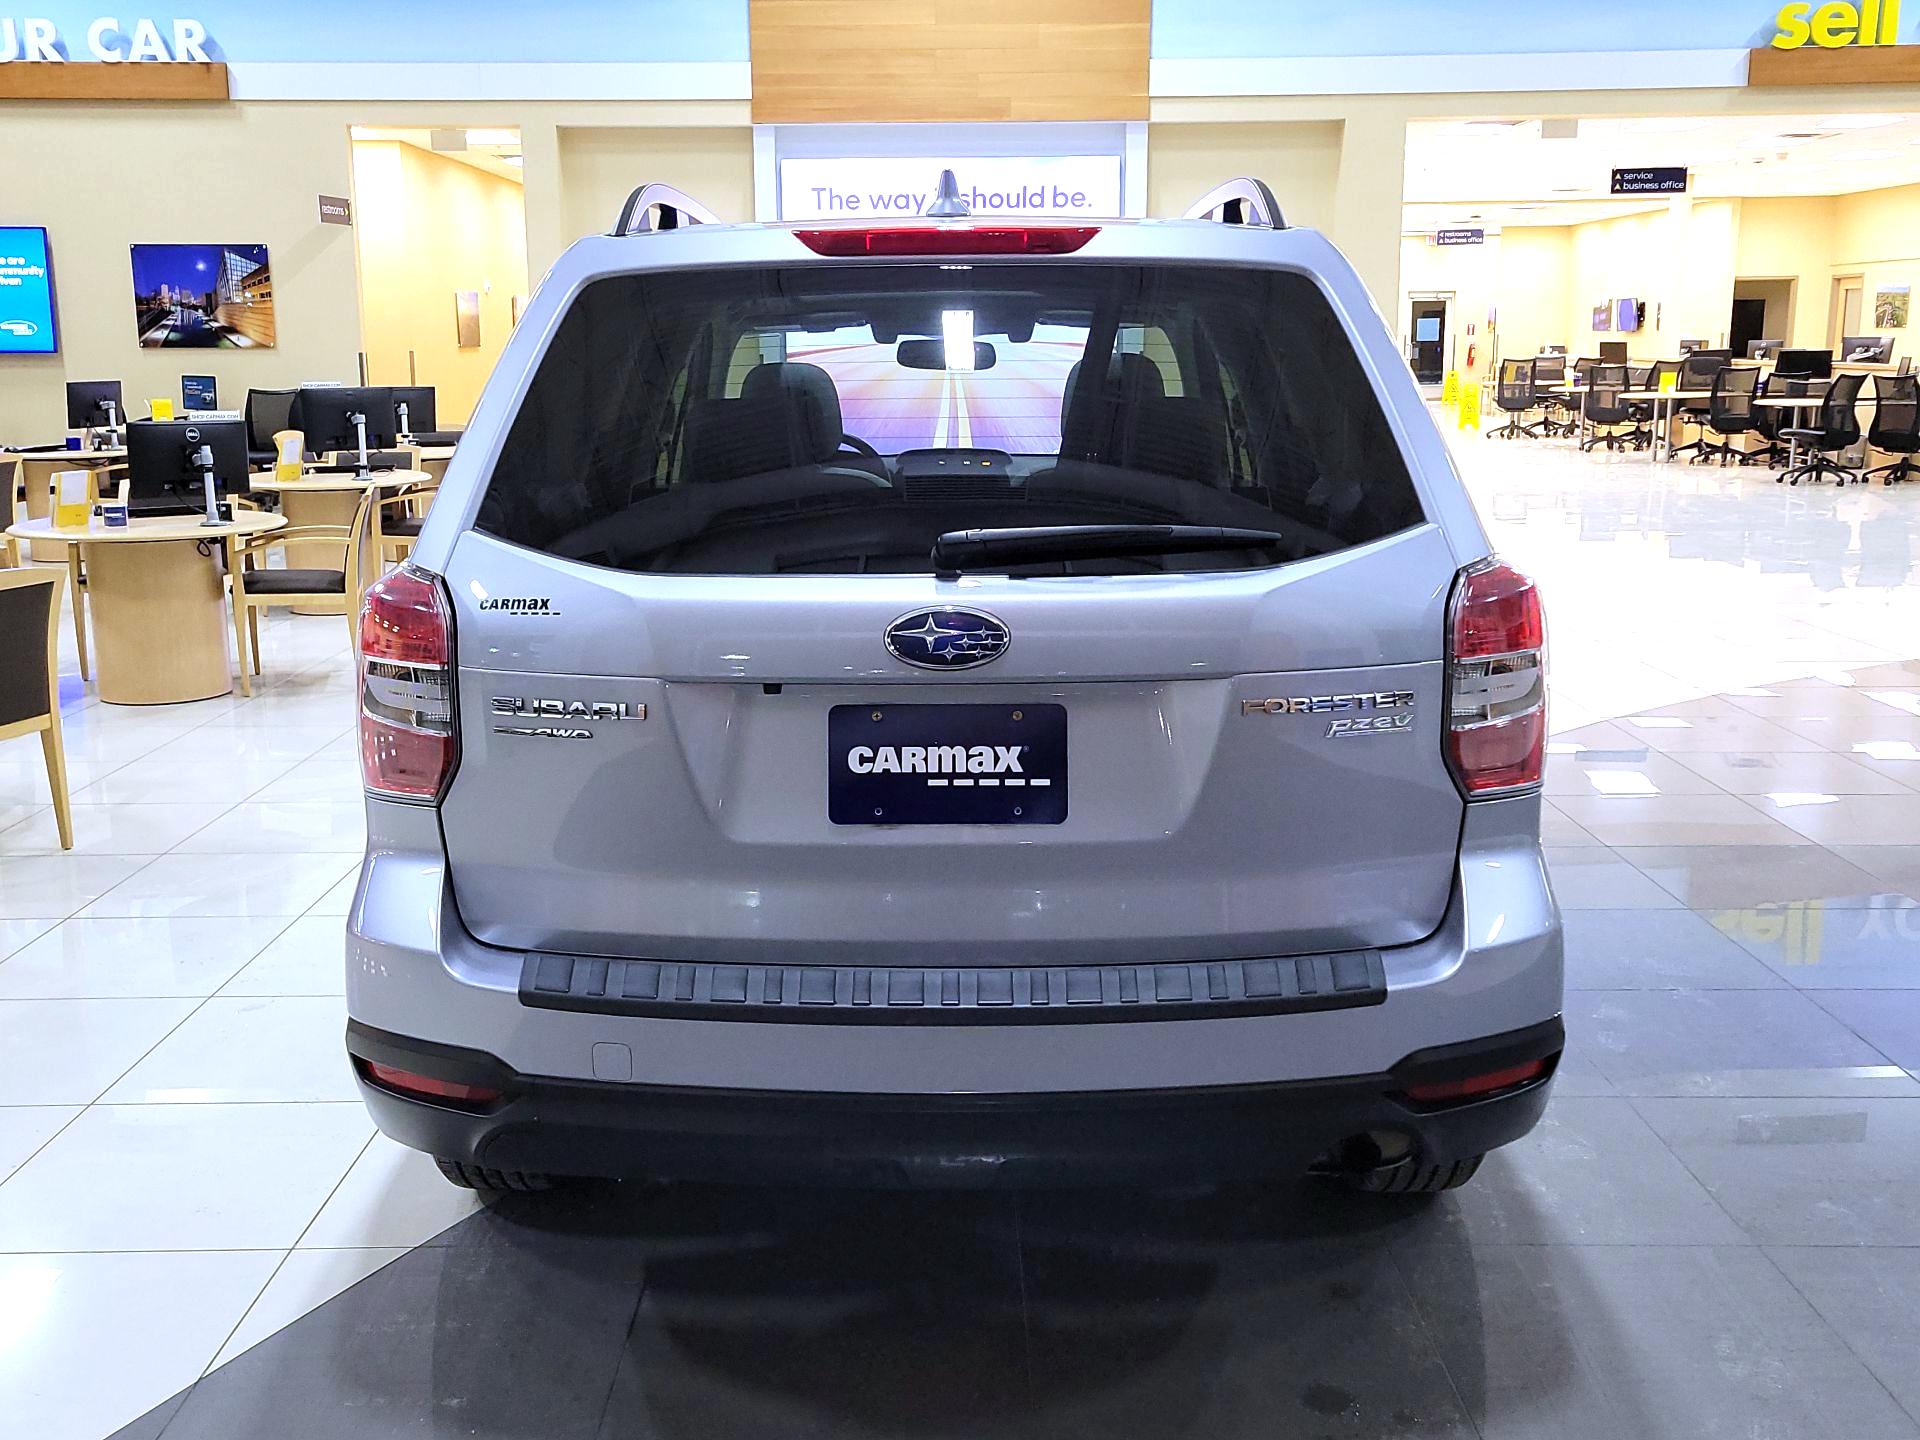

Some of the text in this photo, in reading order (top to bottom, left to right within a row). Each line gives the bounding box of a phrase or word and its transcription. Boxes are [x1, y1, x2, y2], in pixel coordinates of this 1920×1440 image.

[1771, 0, 1900, 49] sell
[87, 17, 213, 64] CAR
[1622, 180, 1685, 190] business office
[1623, 172, 1654, 180] service
[321, 204, 345, 216] restrooms
[811, 187, 861, 211] The
[869, 193, 926, 215] way
[962, 185, 1045, 209] should
[1052, 185, 1093, 208] be.
[490, 696, 647, 721] SUBARU
[1242, 690, 1415, 716] FORESTER
